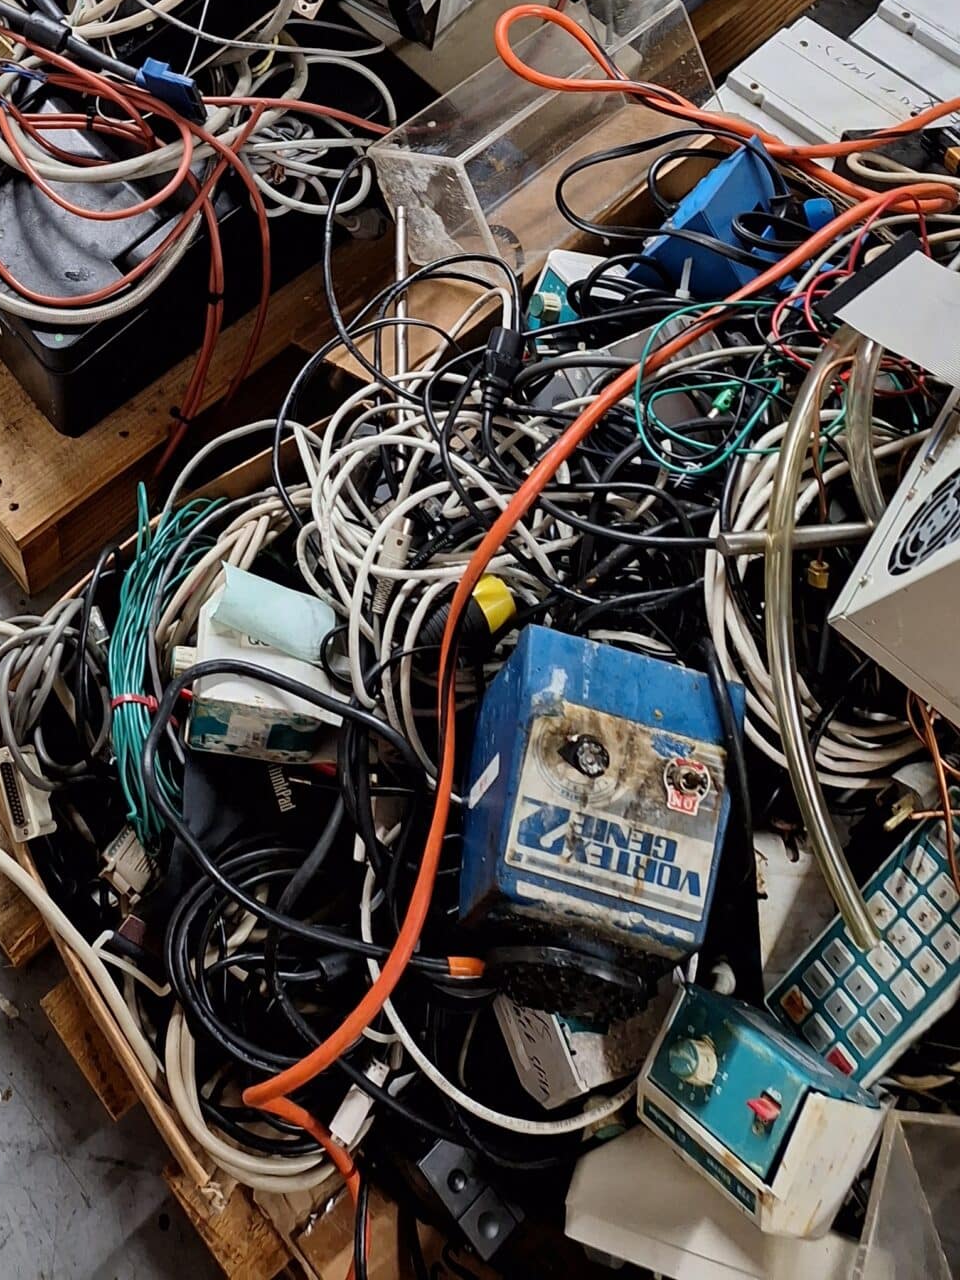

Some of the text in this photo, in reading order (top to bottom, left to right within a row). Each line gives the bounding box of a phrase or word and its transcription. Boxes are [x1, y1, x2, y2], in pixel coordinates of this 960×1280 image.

[268, 760, 295, 812] hinkPad
[669, 791, 696, 811] ON
[517, 796, 678, 863] GENIE 2
[572, 839, 701, 897] VORTEX
